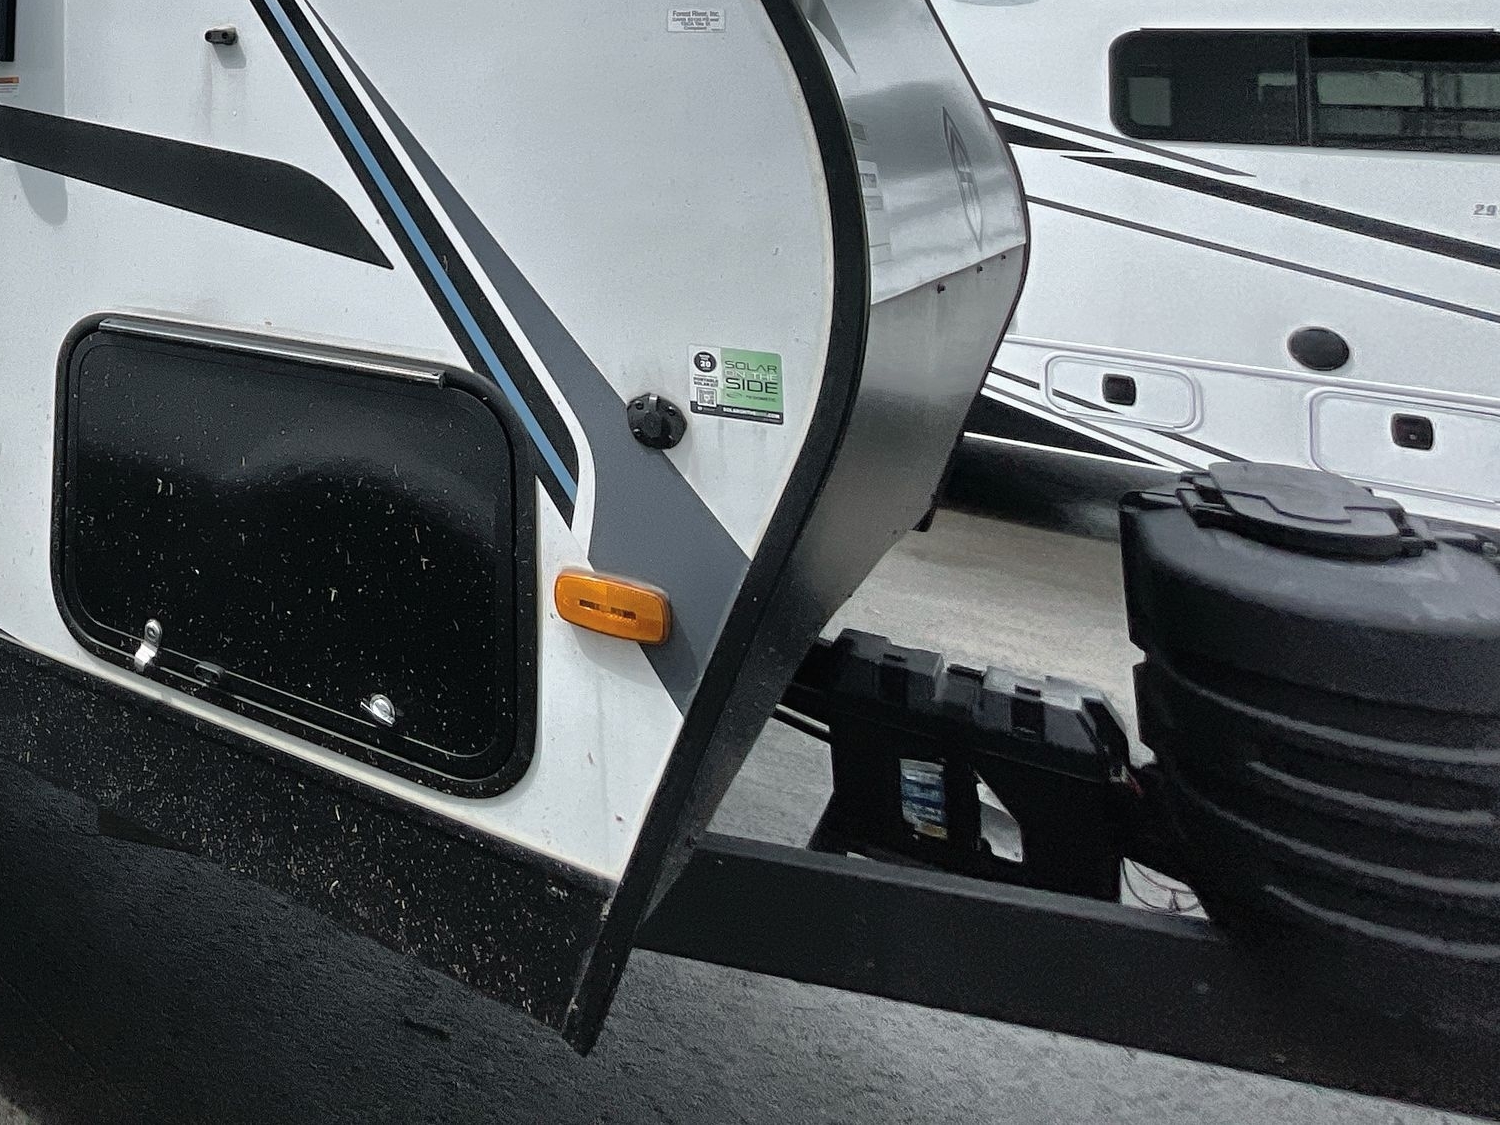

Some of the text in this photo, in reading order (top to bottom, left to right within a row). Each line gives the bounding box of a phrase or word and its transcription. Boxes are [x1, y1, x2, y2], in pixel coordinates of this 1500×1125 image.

[700, 360, 711, 368] 20
[725, 361, 777, 374] SOLAR
[725, 369, 746, 378] ON
[752, 372, 778, 381] THE
[725, 378, 778, 394] SIDE
